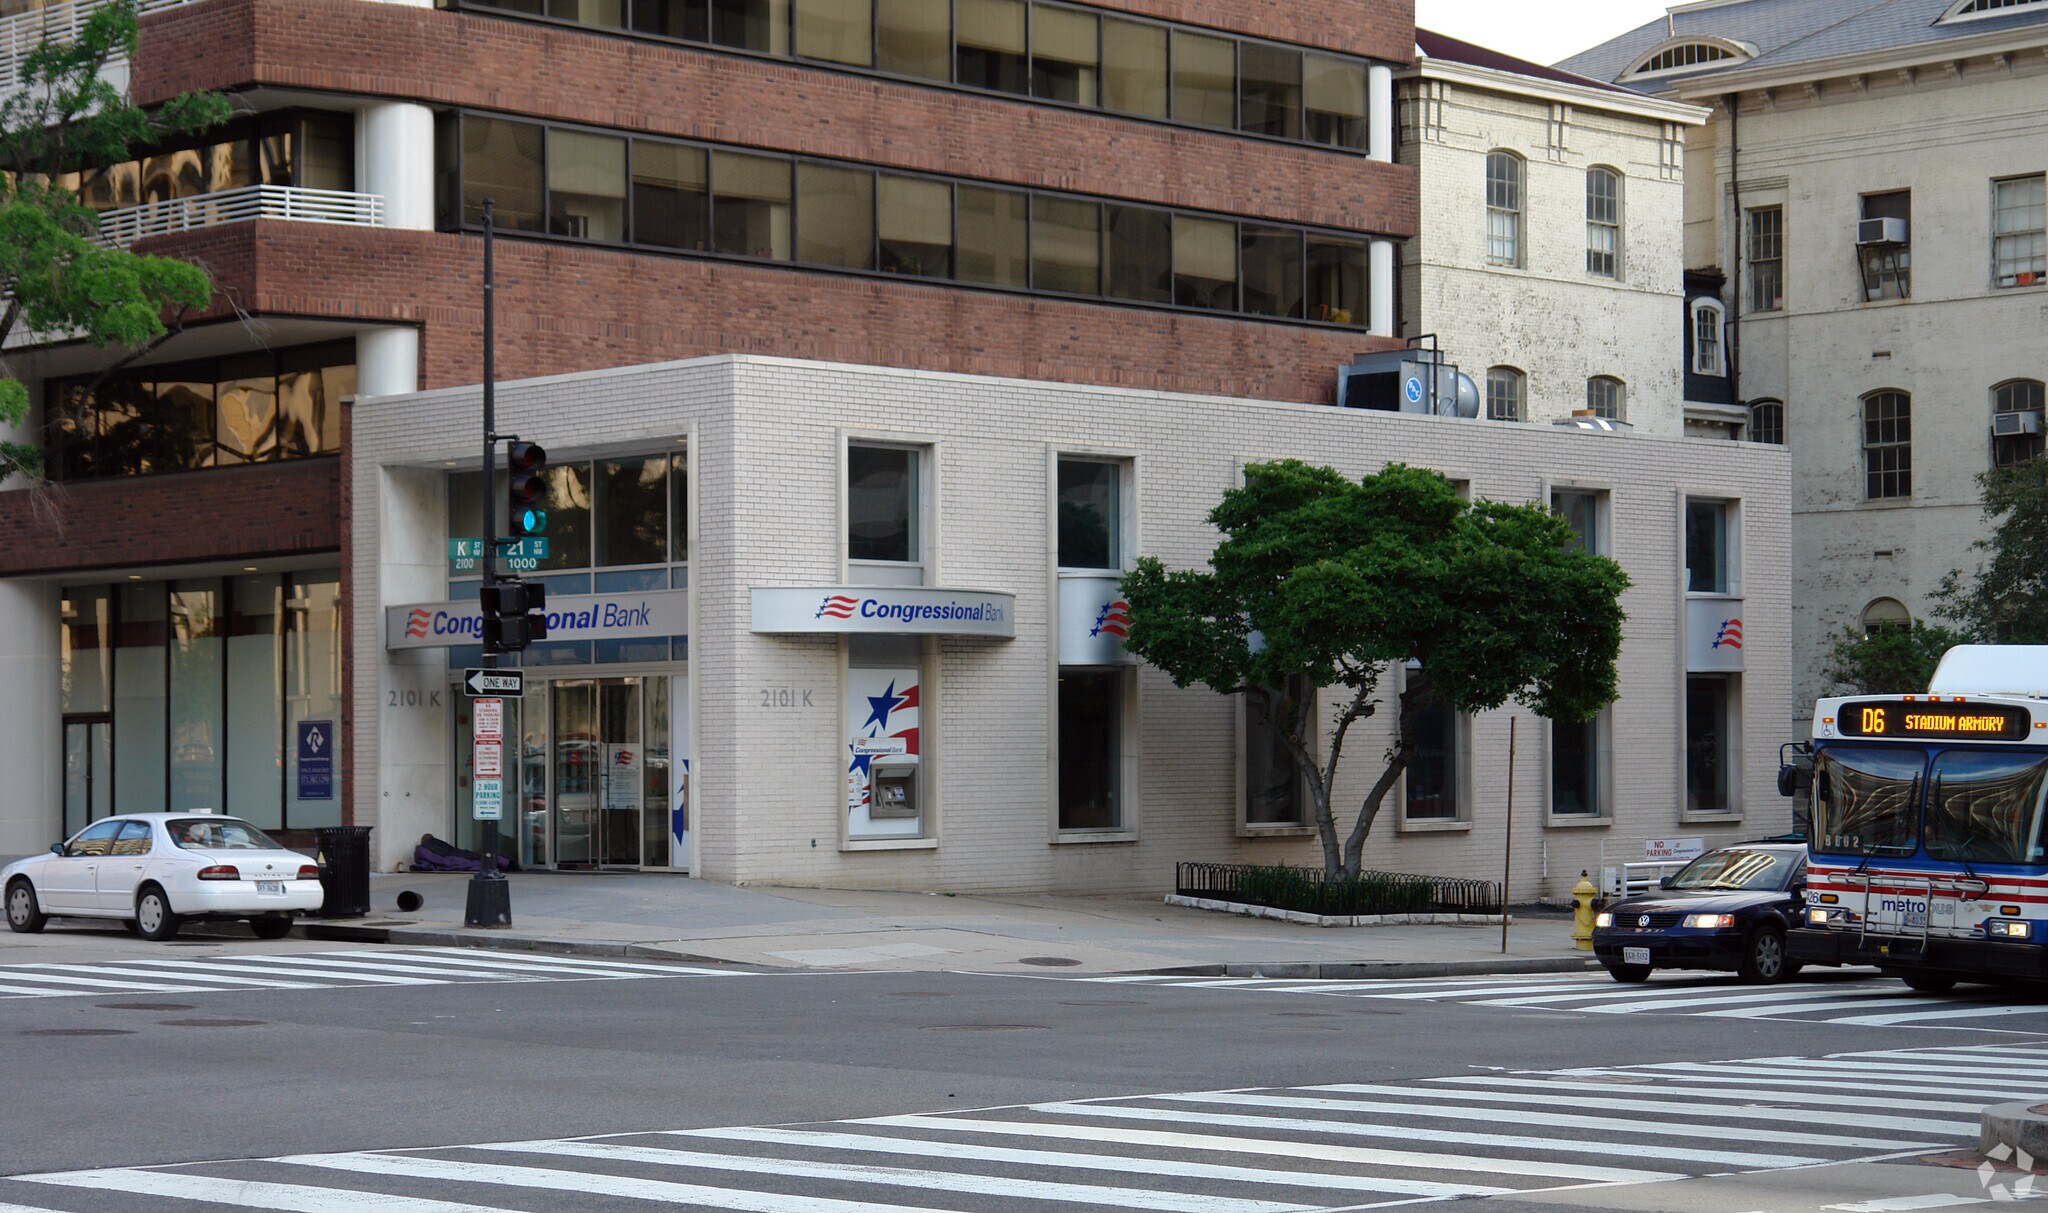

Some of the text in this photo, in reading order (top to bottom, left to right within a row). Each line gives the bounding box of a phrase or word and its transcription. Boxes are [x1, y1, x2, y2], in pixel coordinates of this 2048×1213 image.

[457, 541, 466, 556] K
[506, 540, 524, 555] 21
[456, 558, 474, 569] 2100
[508, 558, 537, 568] 1000
[602, 602, 651, 628] Bank
[861, 599, 1004, 623] Congressional Bank
[484, 678, 517, 688] ONE WAY
[388, 690, 442, 707] 2101 K
[761, 689, 814, 707] 2101 K
[1862, 708, 2004, 733] D6 STADIUM ARMORY
